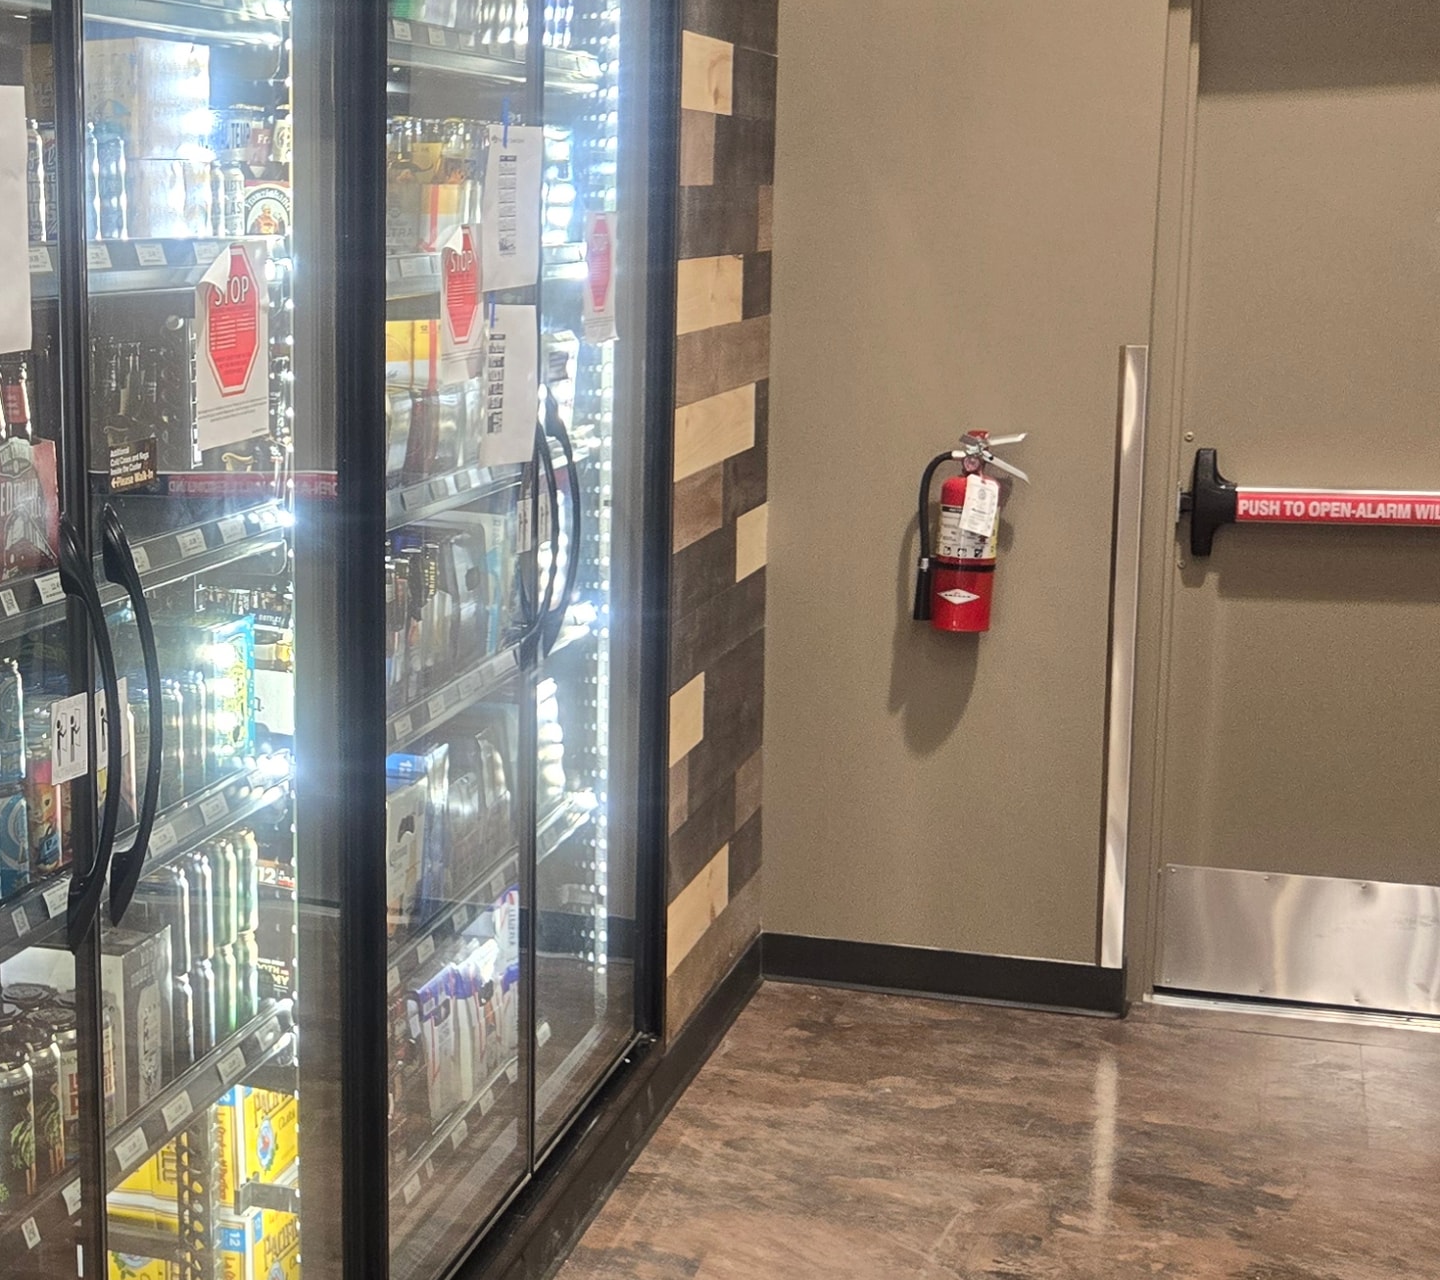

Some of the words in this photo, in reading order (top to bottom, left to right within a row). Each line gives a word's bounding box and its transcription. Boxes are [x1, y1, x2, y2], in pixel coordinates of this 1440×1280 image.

[1239, 499, 1276, 516] PUSH
[1284, 500, 1305, 517] TO
[1308, 500, 1411, 519] OPEN-ALARM
